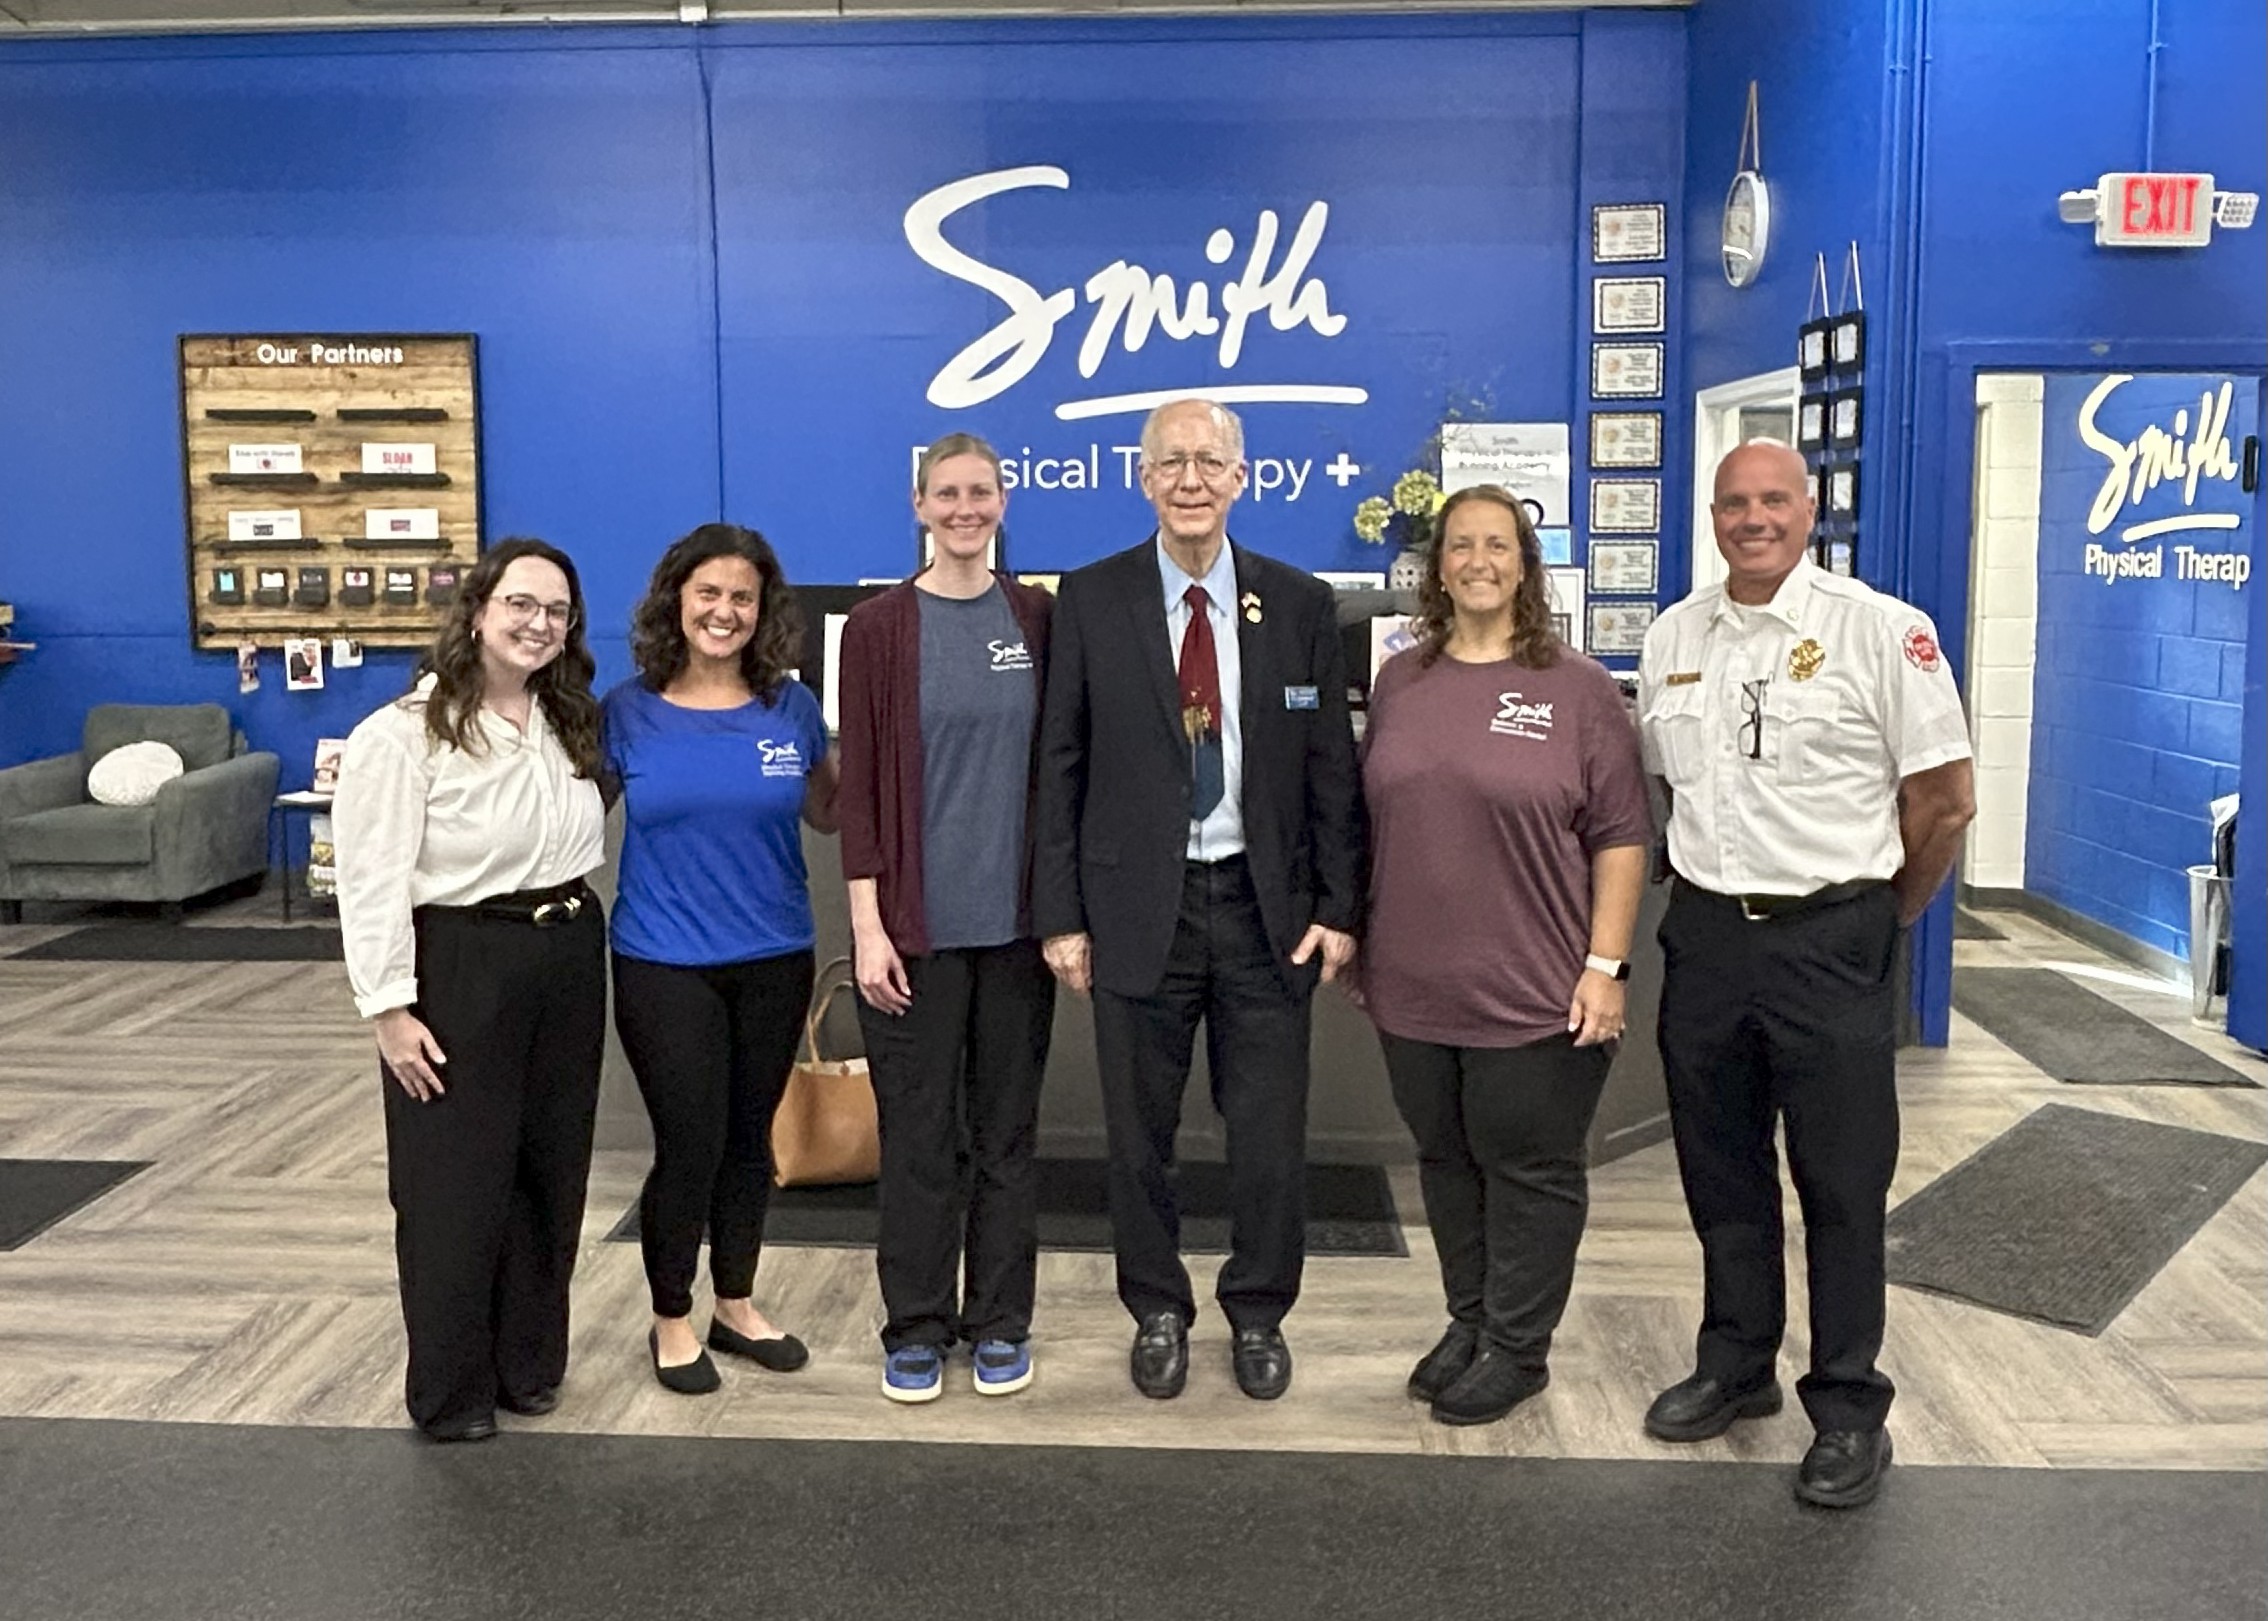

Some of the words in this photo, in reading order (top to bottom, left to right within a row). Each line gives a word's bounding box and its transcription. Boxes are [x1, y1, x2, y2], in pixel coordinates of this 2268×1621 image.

[2121, 177, 2203, 236] EXIT
[904, 165, 1348, 410] Smith
[257, 343, 297, 364] Our
[311, 343, 404, 364] Partners
[912, 443, 1099, 489] sical
[2078, 374, 2239, 535] Smith
[2085, 543, 2163, 586] Physical
